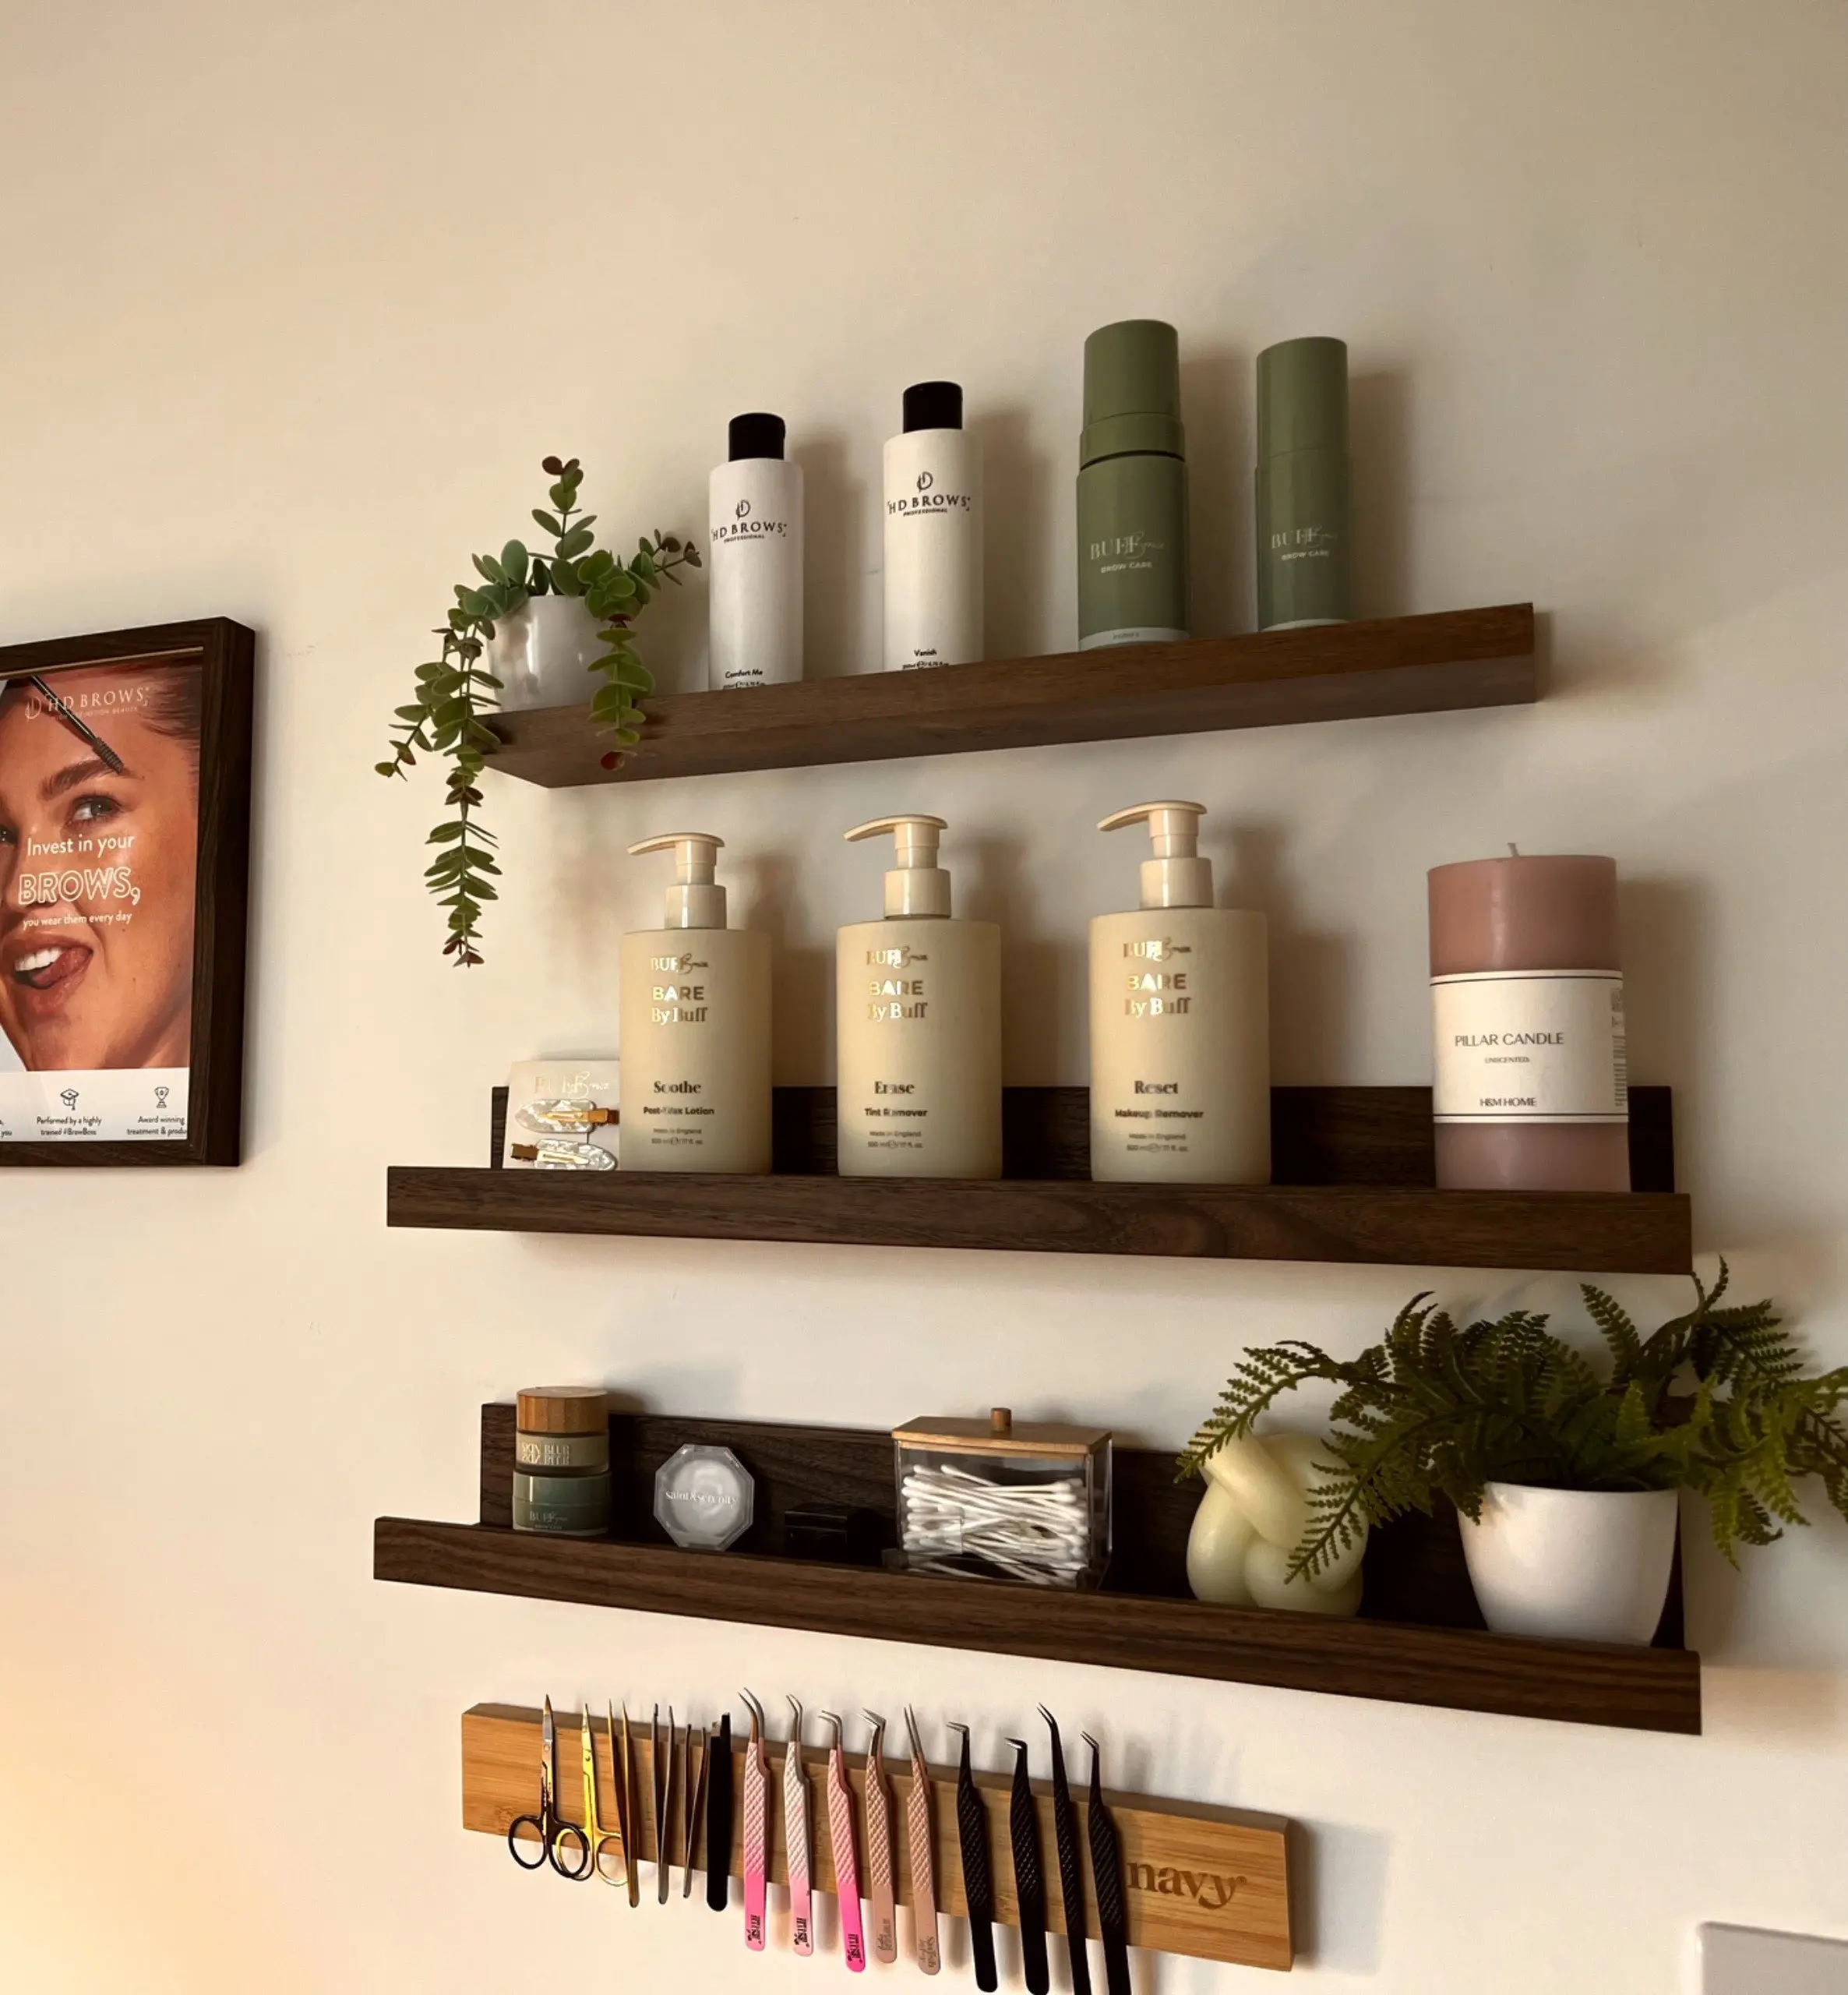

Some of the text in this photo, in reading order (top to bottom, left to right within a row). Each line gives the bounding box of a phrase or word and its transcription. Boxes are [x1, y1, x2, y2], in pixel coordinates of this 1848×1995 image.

[888, 494, 968, 514] HD BROWS
[712, 521, 784, 541] HD BROWS
[913, 648, 937, 657] Vanish
[79, 687, 144, 708] BROWS
[27, 833, 135, 858] Invest in your
[19, 866, 141, 906] BROWS,
[23, 910, 132, 931] you wear them every day
[869, 980, 924, 996] BARE
[1127, 973, 1187, 991] BARE
[652, 985, 705, 1001] BARE
[867, 1001, 928, 1022] By Buff
[1124, 997, 1191, 1019] By Buff
[651, 1006, 708, 1026] By Buff
[1455, 1032, 1564, 1047] PILLAR CANDLE
[1484, 1056, 1530, 1065] UNSCENTED
[653, 1080, 702, 1094] Soothe
[874, 1080, 915, 1095] Erase
[1134, 1080, 1179, 1095] Reset
[1479, 1096, 1537, 1107] H&M HOME
[685, 1107, 714, 1116] Lotion
[864, 1107, 928, 1118] Tint Remover
[1114, 1109, 1204, 1120] Makeup Remover
[36, 1116, 69, 1125] Performed
[69, 1116, 77, 1126] by
[83, 1115, 102, 1126] highly
[160, 1115, 185, 1125] winning
[127, 1127, 159, 1135] treatment
[1127, 1862, 1239, 1909] navy
